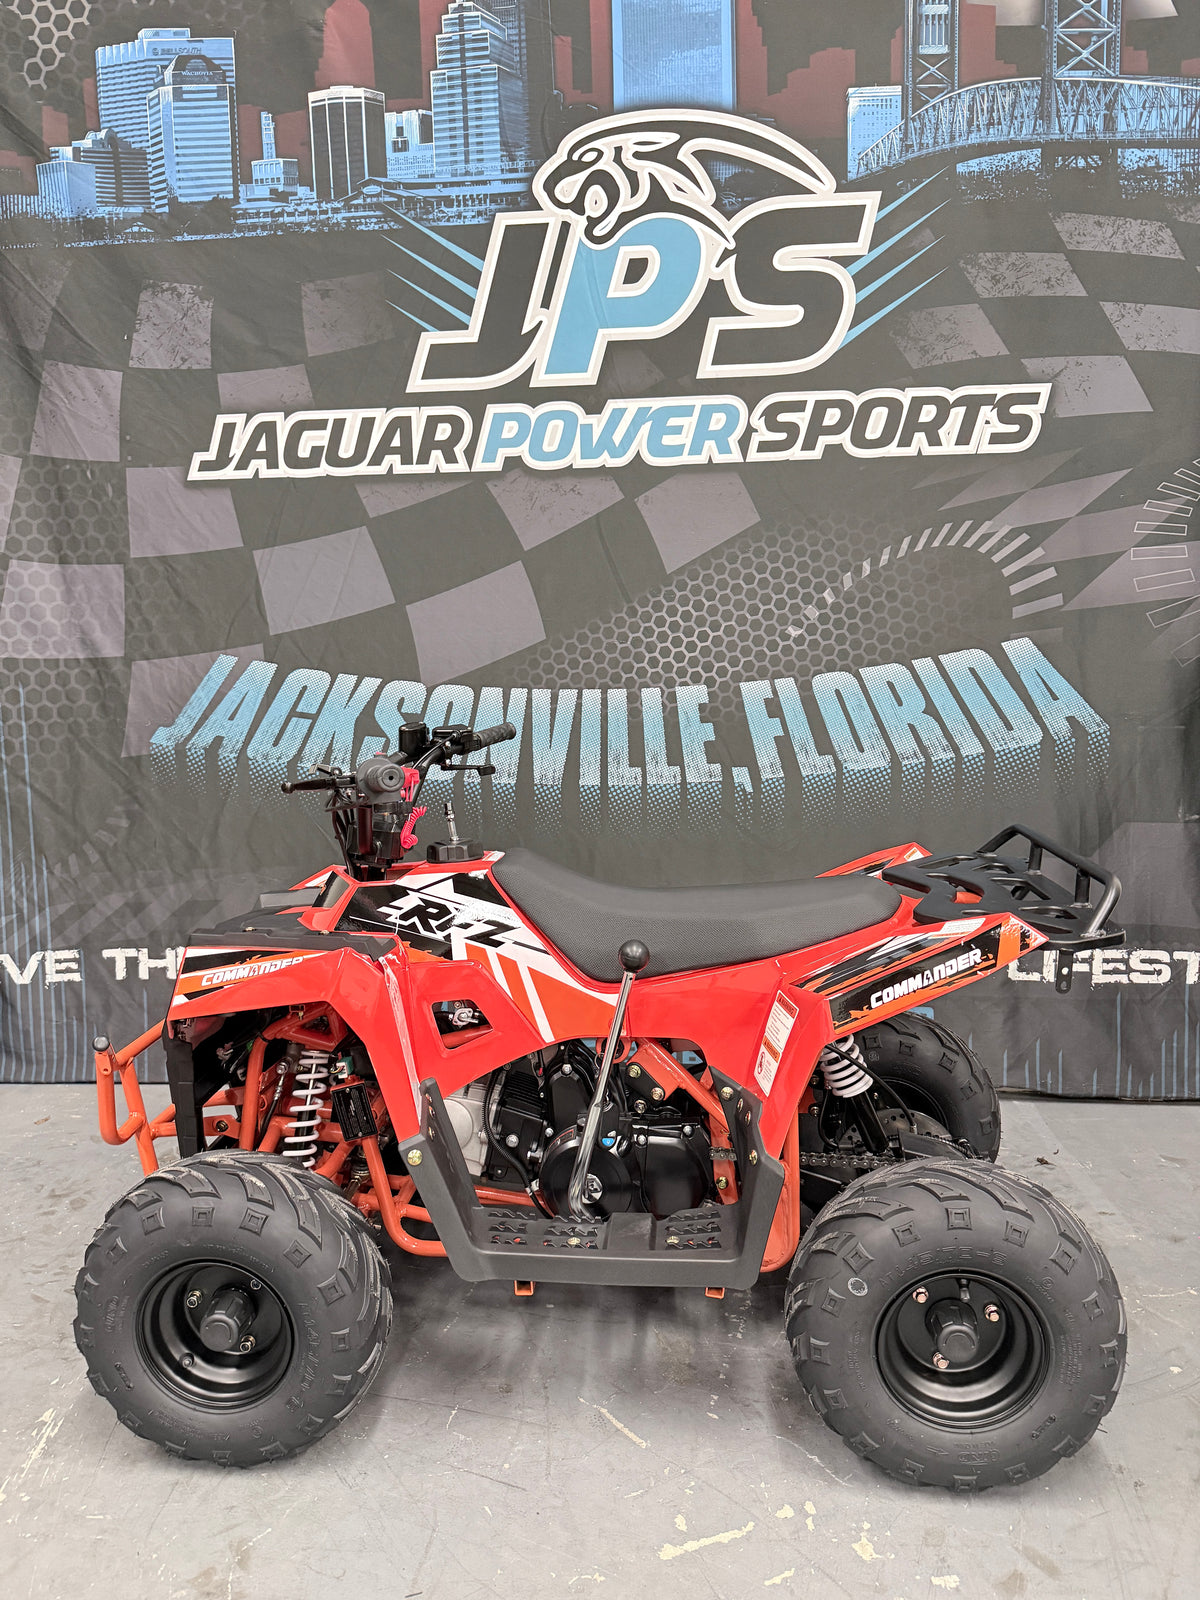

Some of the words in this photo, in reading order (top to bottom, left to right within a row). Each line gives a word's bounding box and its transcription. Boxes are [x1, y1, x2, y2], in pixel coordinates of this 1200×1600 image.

[407, 191, 880, 392] JPS
[188, 406, 474, 480] JAGUAR
[473, 399, 745, 469] POWER
[746, 383, 1052, 462] SPORTS
[201, 956, 304, 987] COMMANDER
[870, 948, 982, 1009] COMMANDER
